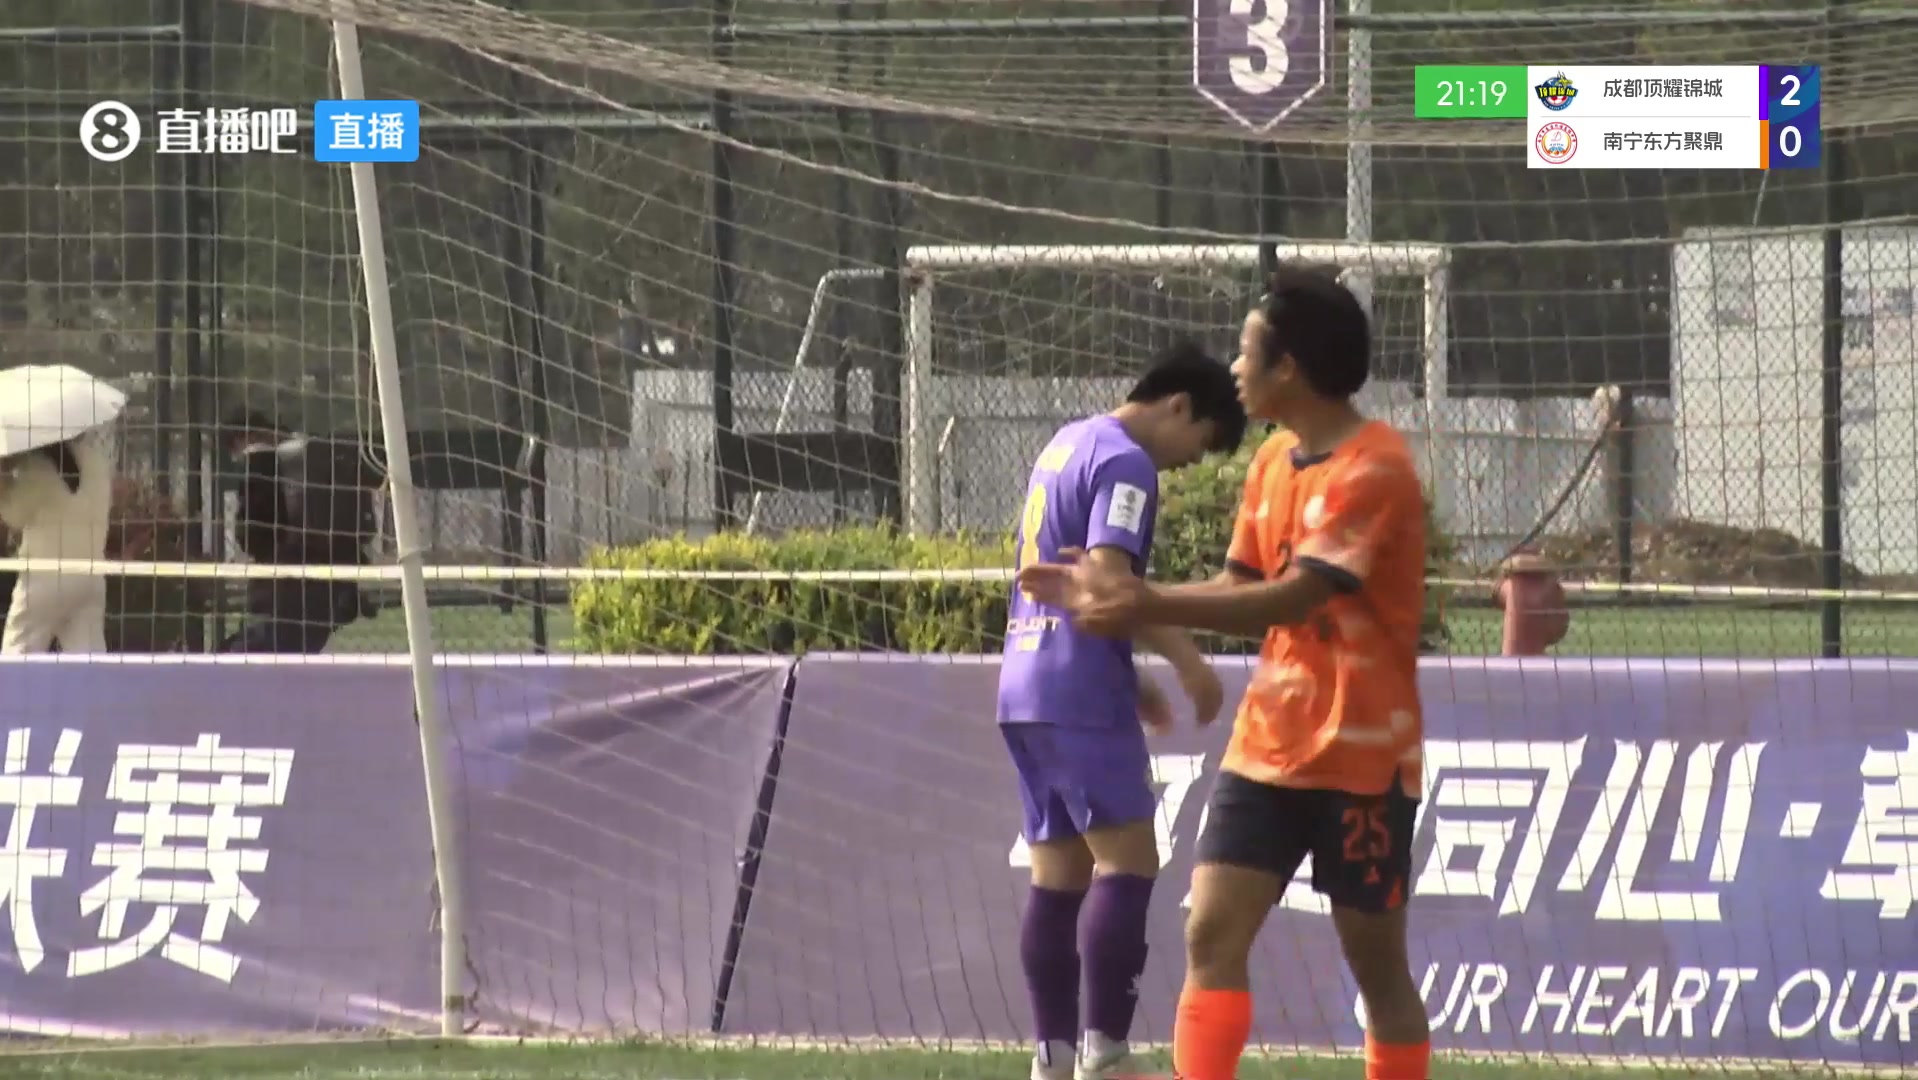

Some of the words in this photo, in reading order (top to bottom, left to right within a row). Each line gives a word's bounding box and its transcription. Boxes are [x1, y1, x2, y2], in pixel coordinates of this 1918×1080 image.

[1227, 0, 1290, 95] 3
[1341, 806, 1393, 862] 25
[1353, 963, 1509, 1034] UR
[1521, 964, 1760, 1039] HEART
[1768, 967, 1918, 1044] OUR
